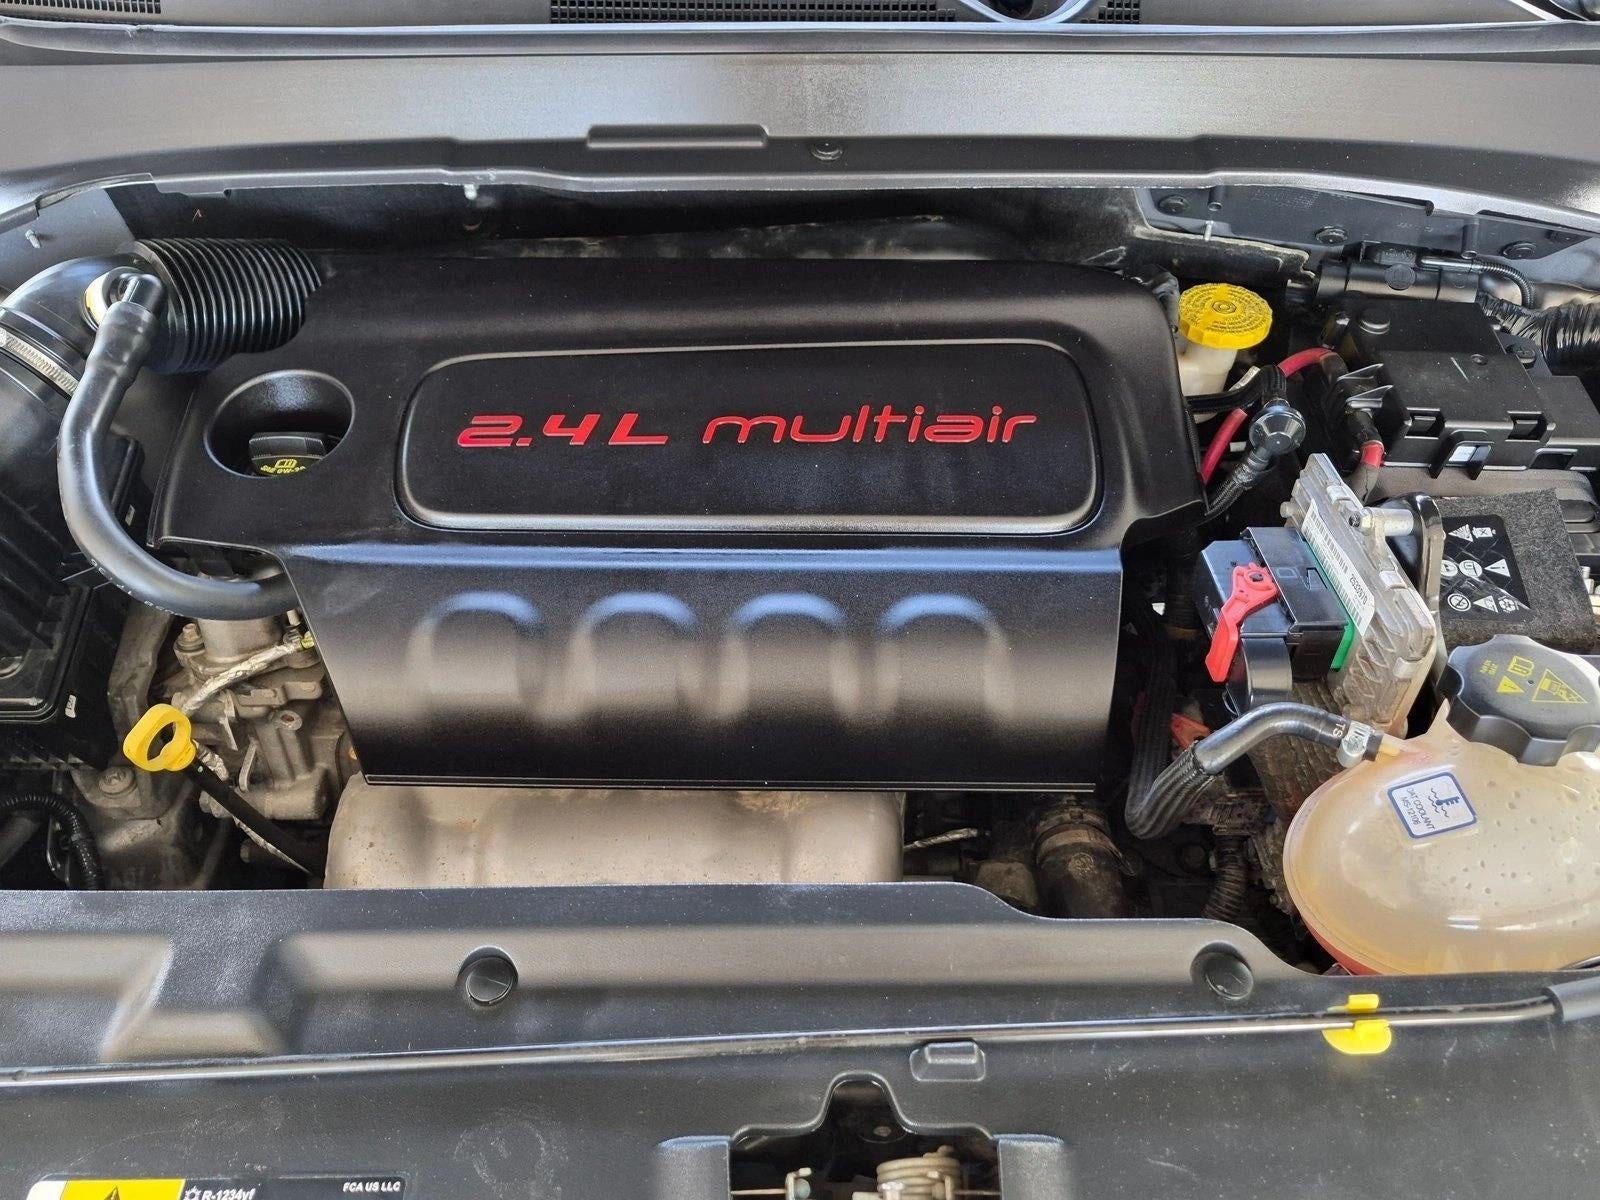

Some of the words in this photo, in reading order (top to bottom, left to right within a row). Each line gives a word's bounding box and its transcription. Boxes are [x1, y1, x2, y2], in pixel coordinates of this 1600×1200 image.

[457, 413, 668, 447] 2.4L
[702, 405, 1038, 444] multiair
[1413, 799, 1436, 829] COOLANT
[201, 1187, 256, 1200] R-1234yf
[342, 1181, 363, 1193] FCA
[365, 1181, 380, 1193] US
[381, 1180, 401, 1193] LLC
